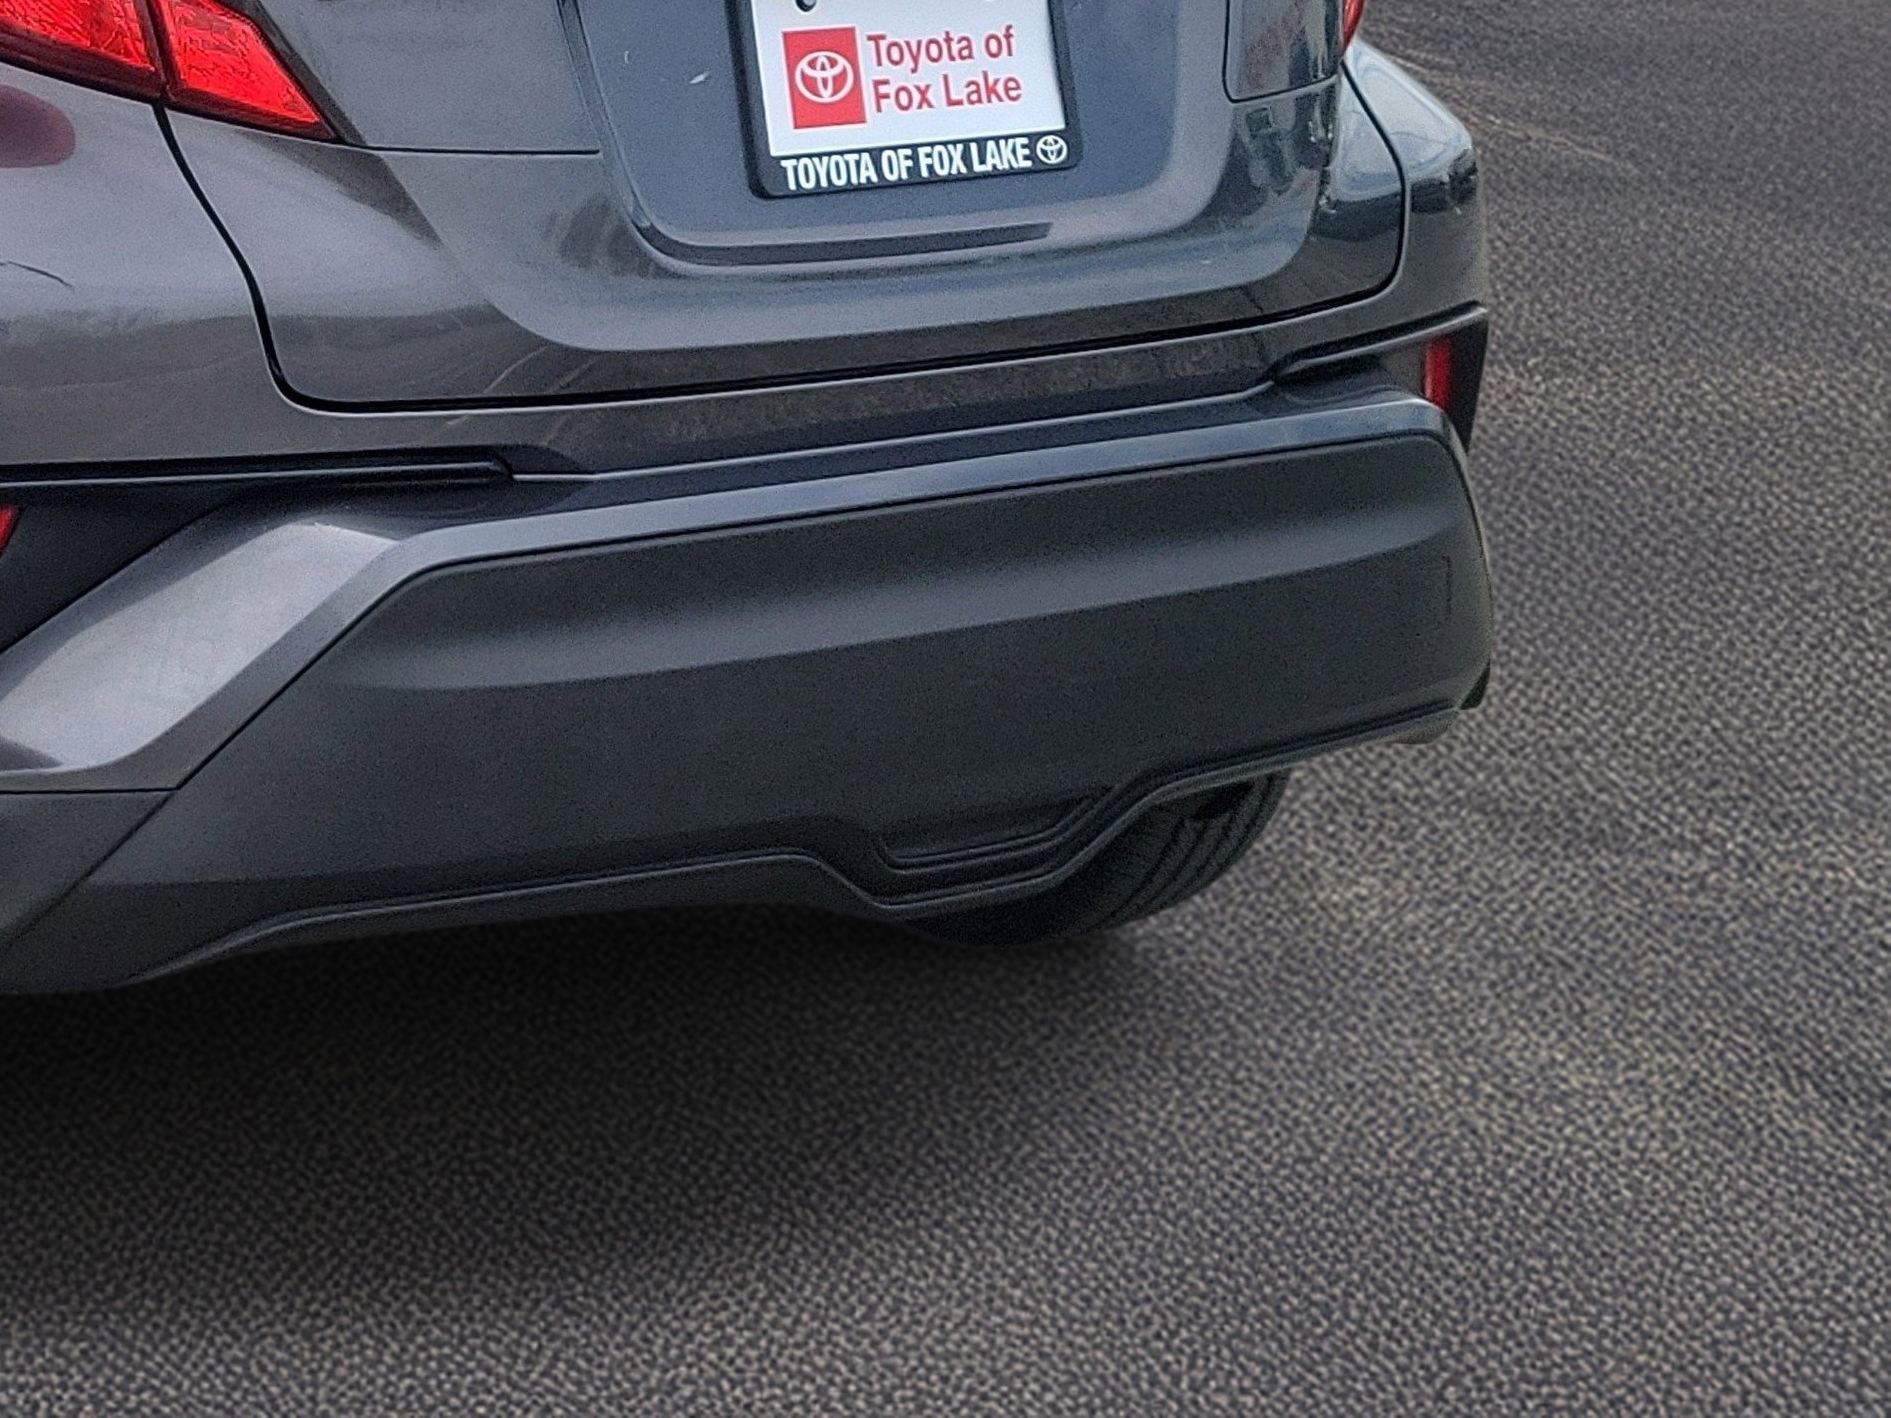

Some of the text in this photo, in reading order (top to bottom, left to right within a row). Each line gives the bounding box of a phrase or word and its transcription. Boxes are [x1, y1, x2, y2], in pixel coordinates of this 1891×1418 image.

[866, 25, 1014, 74] Toyota of
[872, 71, 1022, 113] Fox Lake
[780, 137, 1033, 191] TOYOTA OF FOX LAKE
